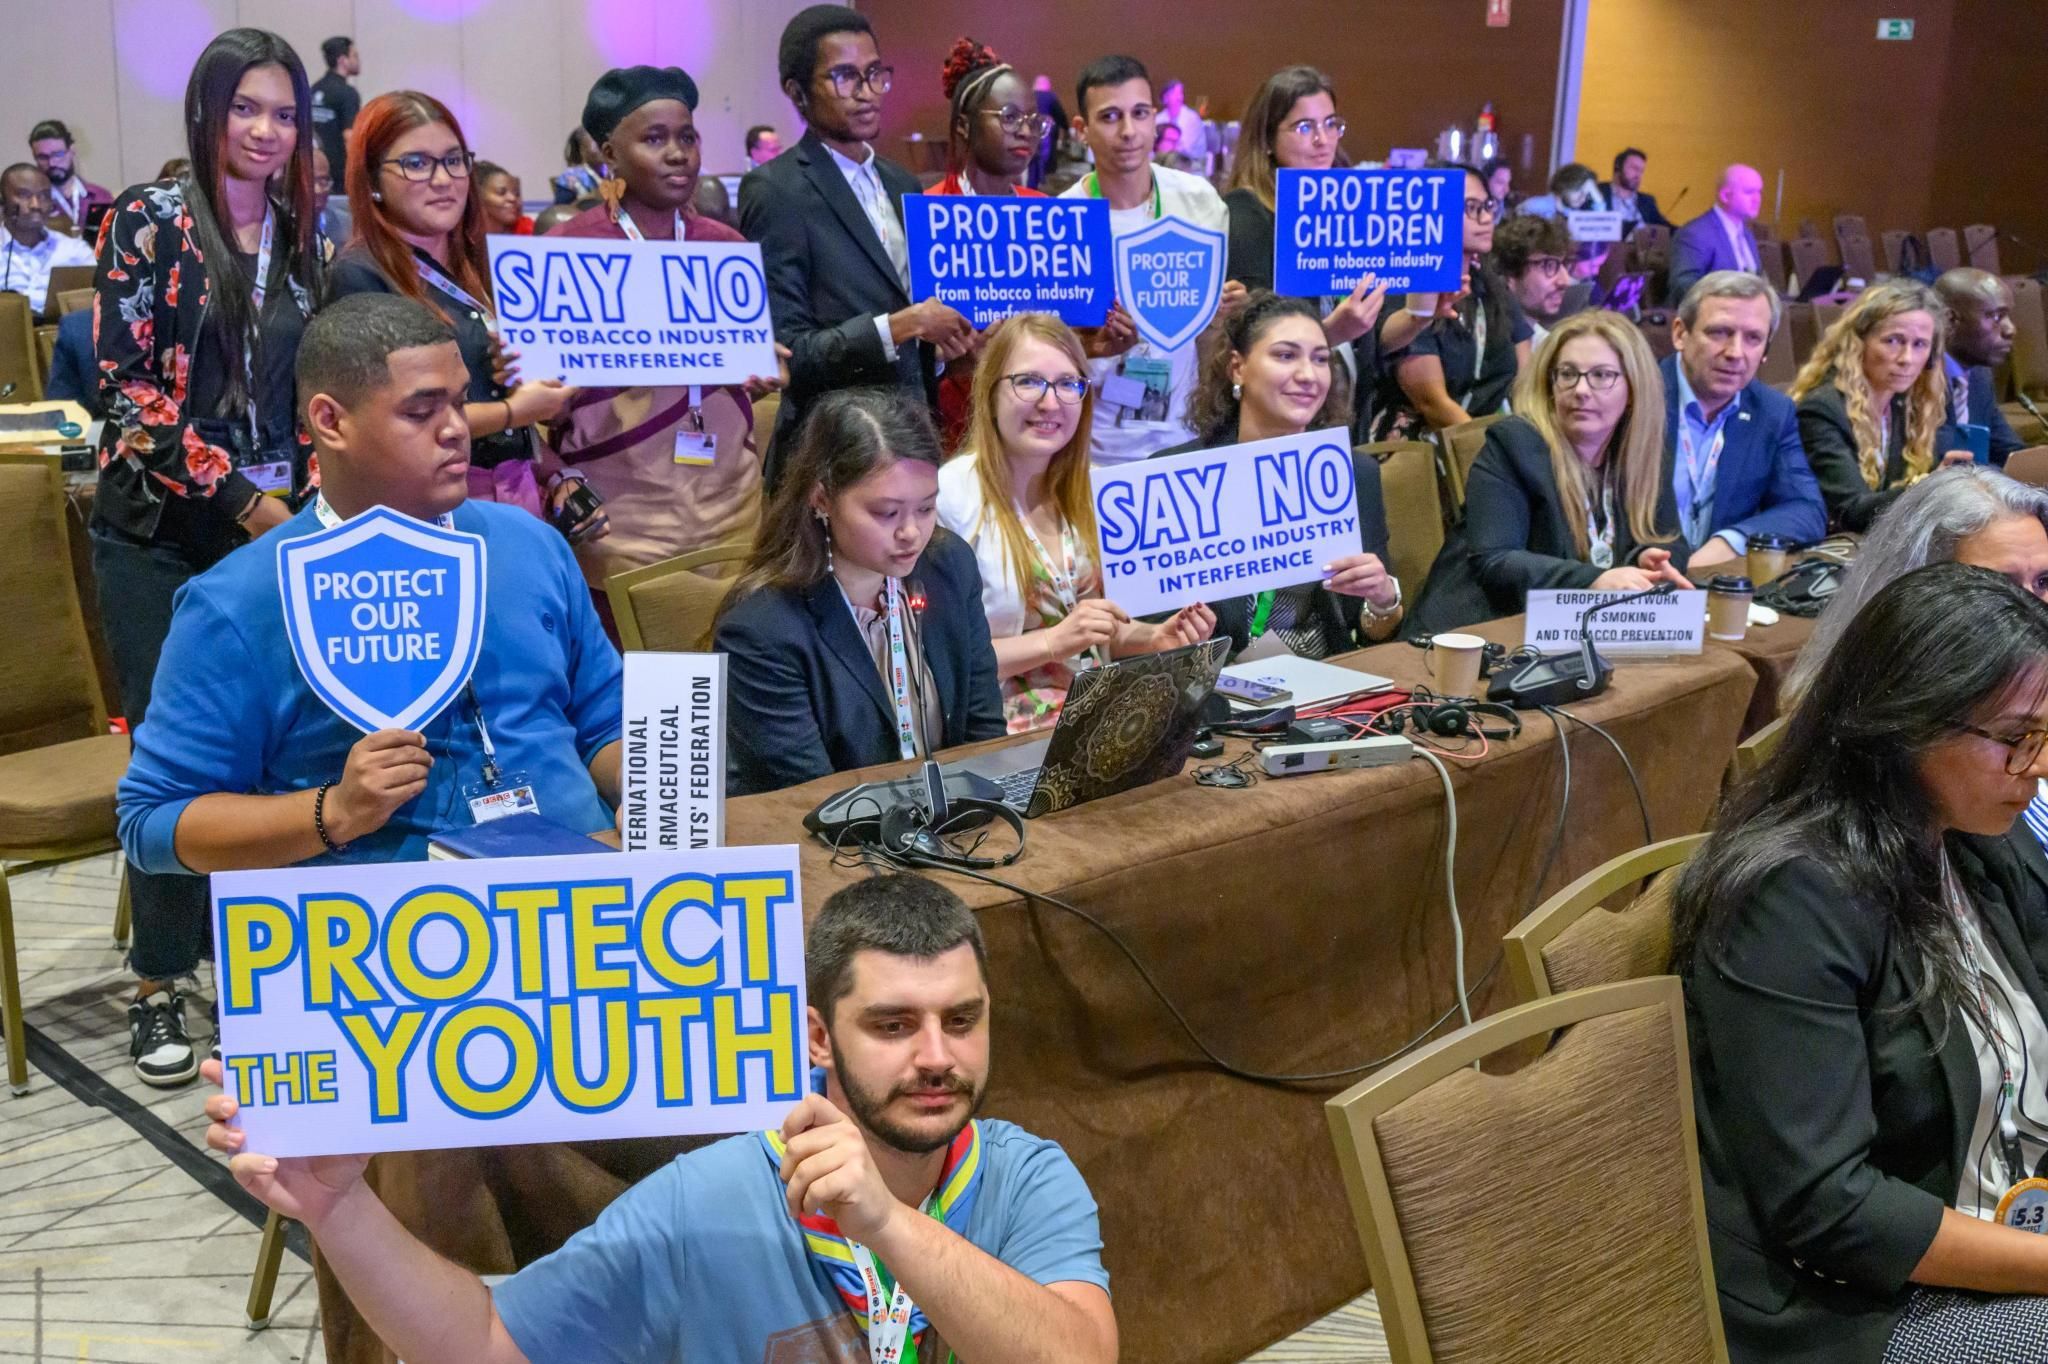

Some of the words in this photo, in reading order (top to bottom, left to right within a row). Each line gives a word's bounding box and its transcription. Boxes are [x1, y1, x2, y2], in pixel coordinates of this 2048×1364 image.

[1298, 175, 1446, 212] PROTECT
[928, 202, 1088, 241] PROTECT
[1294, 213, 1444, 248] CHILDREN
[929, 243, 1091, 279] CHILDREN
[1131, 251, 1206, 271] PROTECT
[1296, 251, 1329, 270] from
[1333, 250, 1386, 269] tobacco
[1389, 249, 1444, 271] industry
[494, 249, 632, 324] SAY
[662, 255, 767, 323] NO
[934, 281, 970, 302] from
[974, 281, 1032, 301] tobacco
[1035, 281, 1095, 305] industry
[1150, 270, 1190, 289] OUR
[973, 304, 1061, 324] interfe
[1137, 288, 1200, 308] FUTURE
[504, 328, 536, 345] TO
[542, 328, 652, 346] TOBACCO
[658, 328, 769, 345] INDUSTRY
[560, 352, 725, 369] INTERFERENCE
[1096, 462, 1228, 556] SAY
[1254, 443, 1353, 528] NO
[1105, 559, 1137, 579] TO
[1142, 538, 1246, 572] TOBACCO
[1251, 516, 1357, 550] INDUSTRY
[313, 568, 448, 601] PROTECT
[1159, 549, 1314, 594] INTERFERENCE
[350, 601, 422, 631] OUR
[1556, 593, 1619, 606] EUROPEAN
[1575, 611, 1598, 623] FR
[1601, 611, 1657, 624] SMOKING
[327, 632, 441, 665] FUTURE
[1536, 629, 1560, 641] AND
[1621, 629, 1693, 641] PREVENTION
[690, 675, 711, 799] FEDERATION
[659, 704, 679, 850] RMACEUTICAL
[218, 869, 794, 1017] PROTECT
[225, 1048, 339, 1108] THE
[330, 985, 804, 1124] YOUTH
[2015, 1205, 2045, 1226] 5.3
